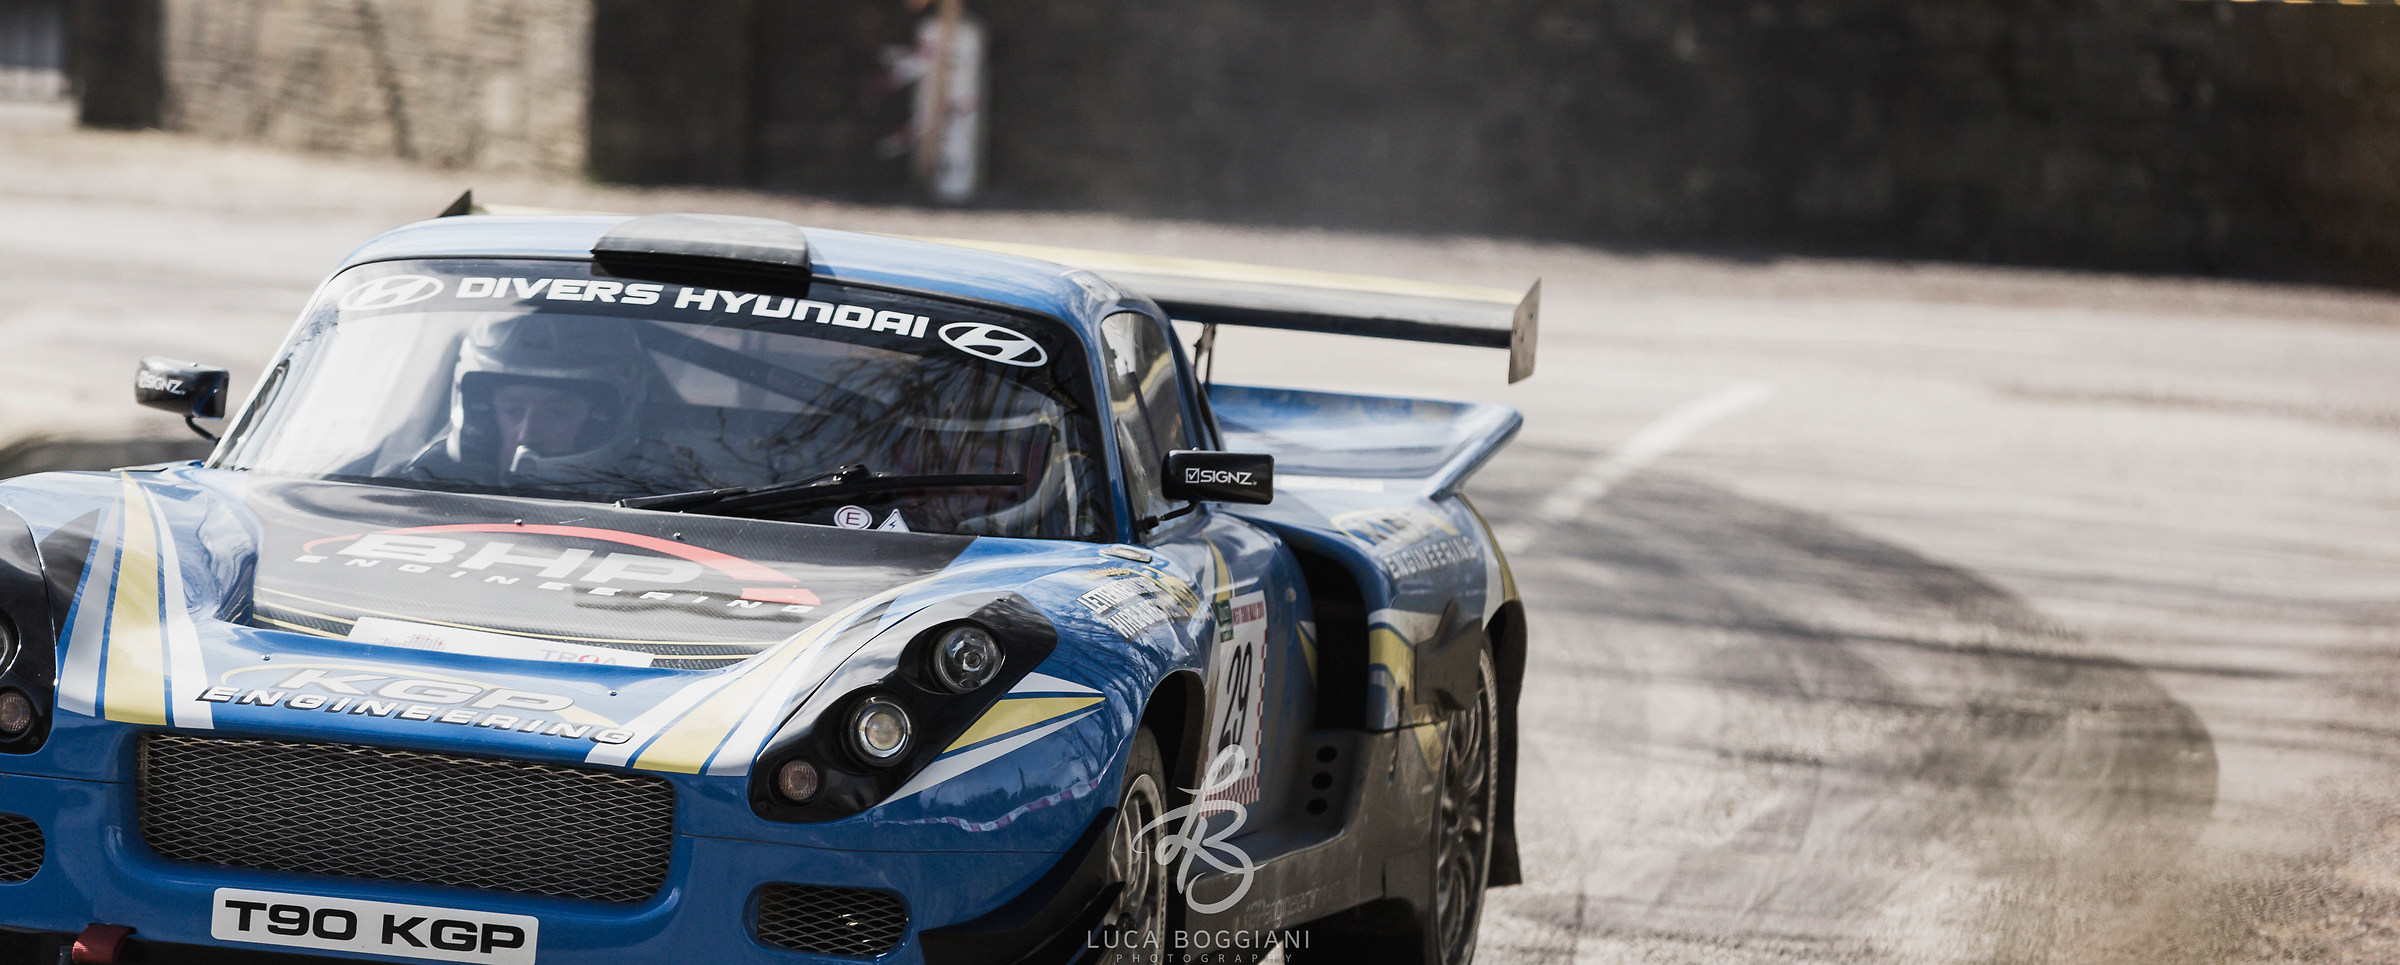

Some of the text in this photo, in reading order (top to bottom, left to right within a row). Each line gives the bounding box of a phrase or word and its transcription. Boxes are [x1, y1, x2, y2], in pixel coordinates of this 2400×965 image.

[455, 277, 930, 338] DIVERS HYUNDAI
[846, 512, 860, 525] E
[294, 555, 815, 613] ENGINEERING
[337, 533, 702, 584] BHP
[196, 686, 635, 745] ENGINEERING
[269, 669, 575, 712] KGP
[1217, 641, 1252, 755] 29
[224, 900, 526, 954] T90 KGP
